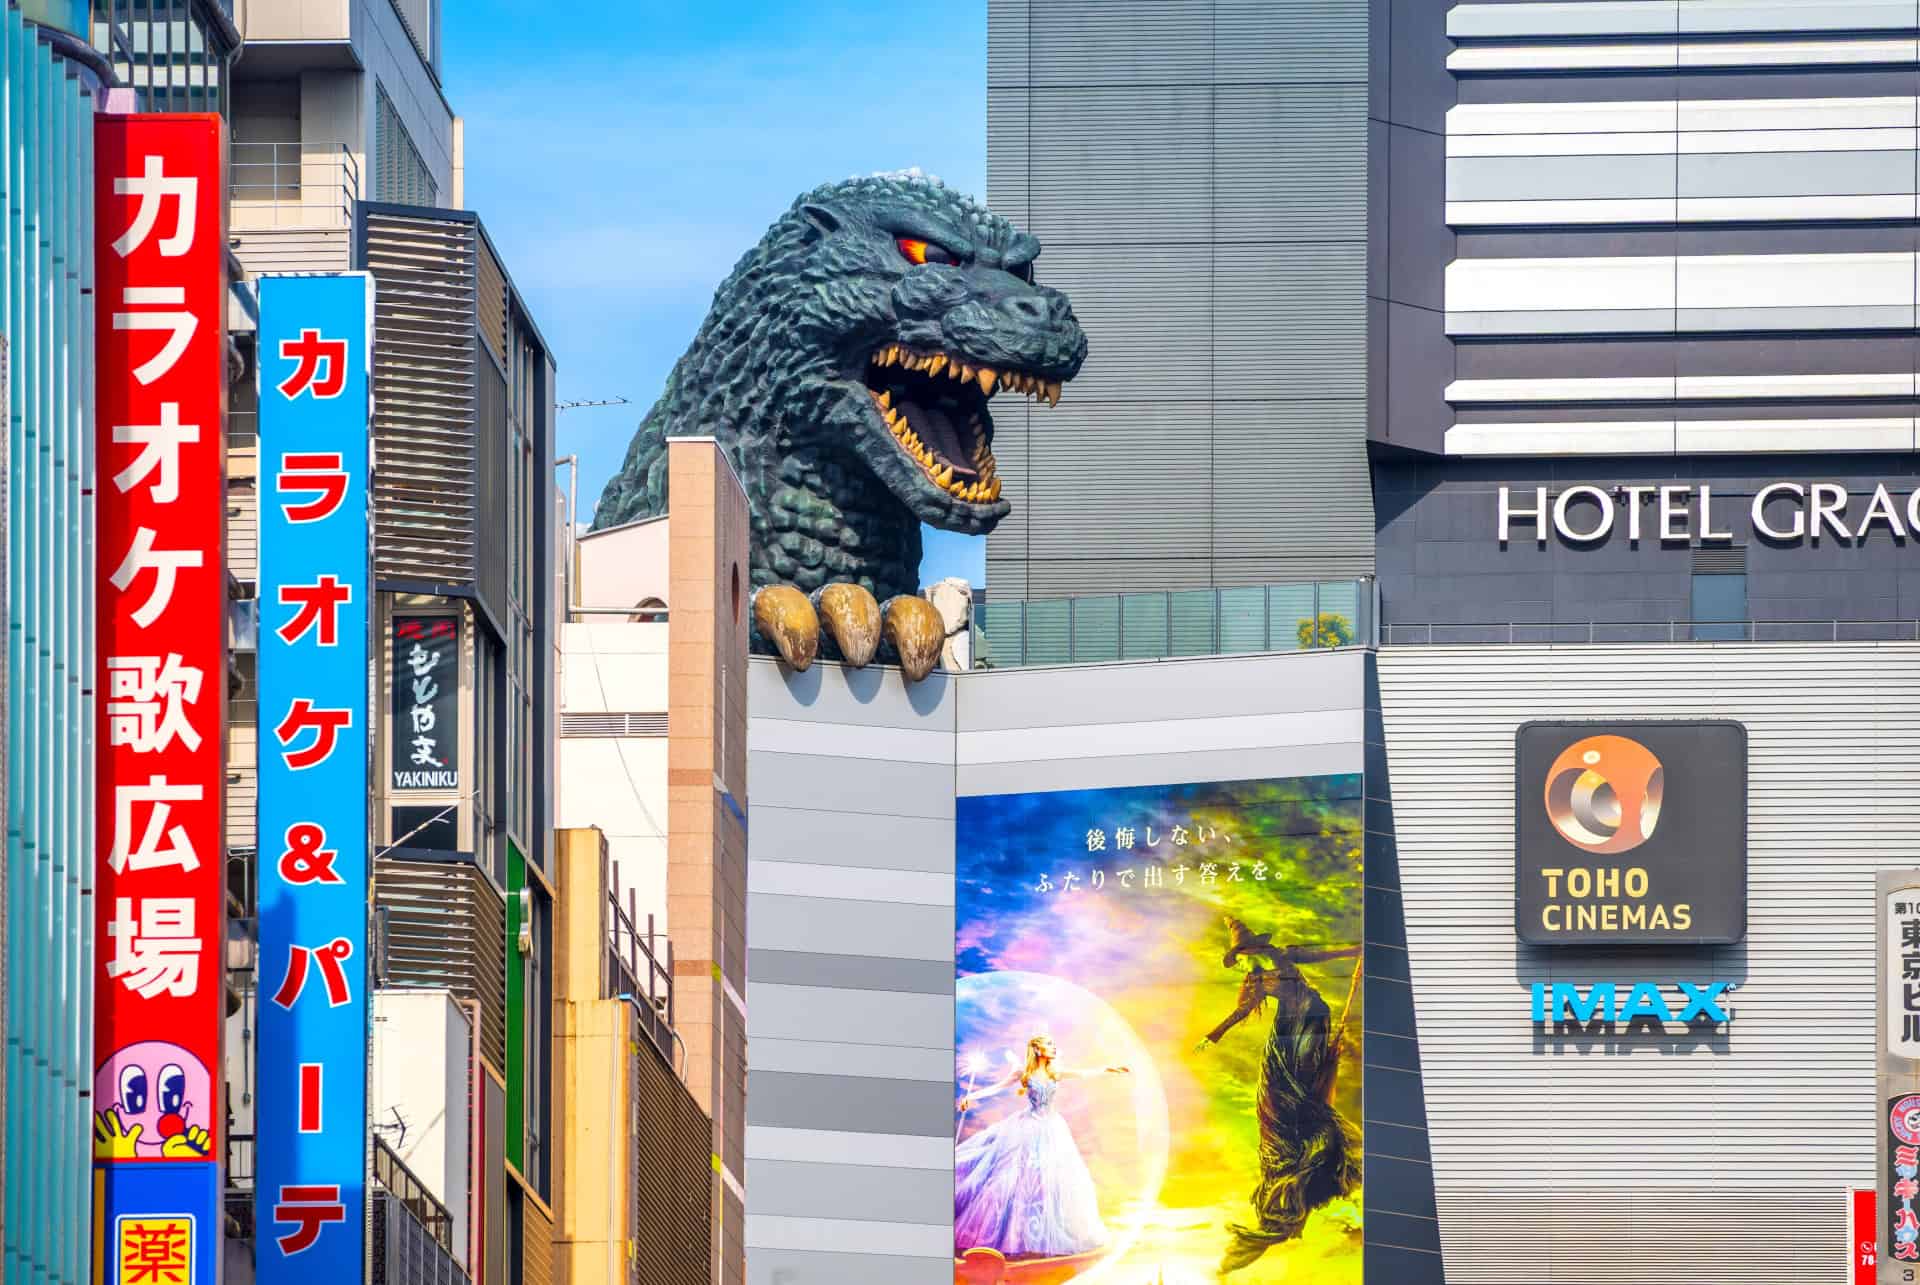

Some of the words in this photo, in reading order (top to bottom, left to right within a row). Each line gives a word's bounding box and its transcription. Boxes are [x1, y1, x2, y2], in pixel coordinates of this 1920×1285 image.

[1498, 485, 1733, 541] HOTEL
[1751, 482, 1920, 539] GRA
[110, 154, 204, 1000] カラオケ歌広場
[394, 770, 459, 788] YAKINIKU
[1086, 824, 1233, 852] 後悔しない、
[1034, 860, 1285, 894] ふたりで出す答えを。
[1541, 867, 1649, 898] TOHO
[1541, 903, 1693, 931] CINEMAS
[124, 1223, 187, 1284] 薬
